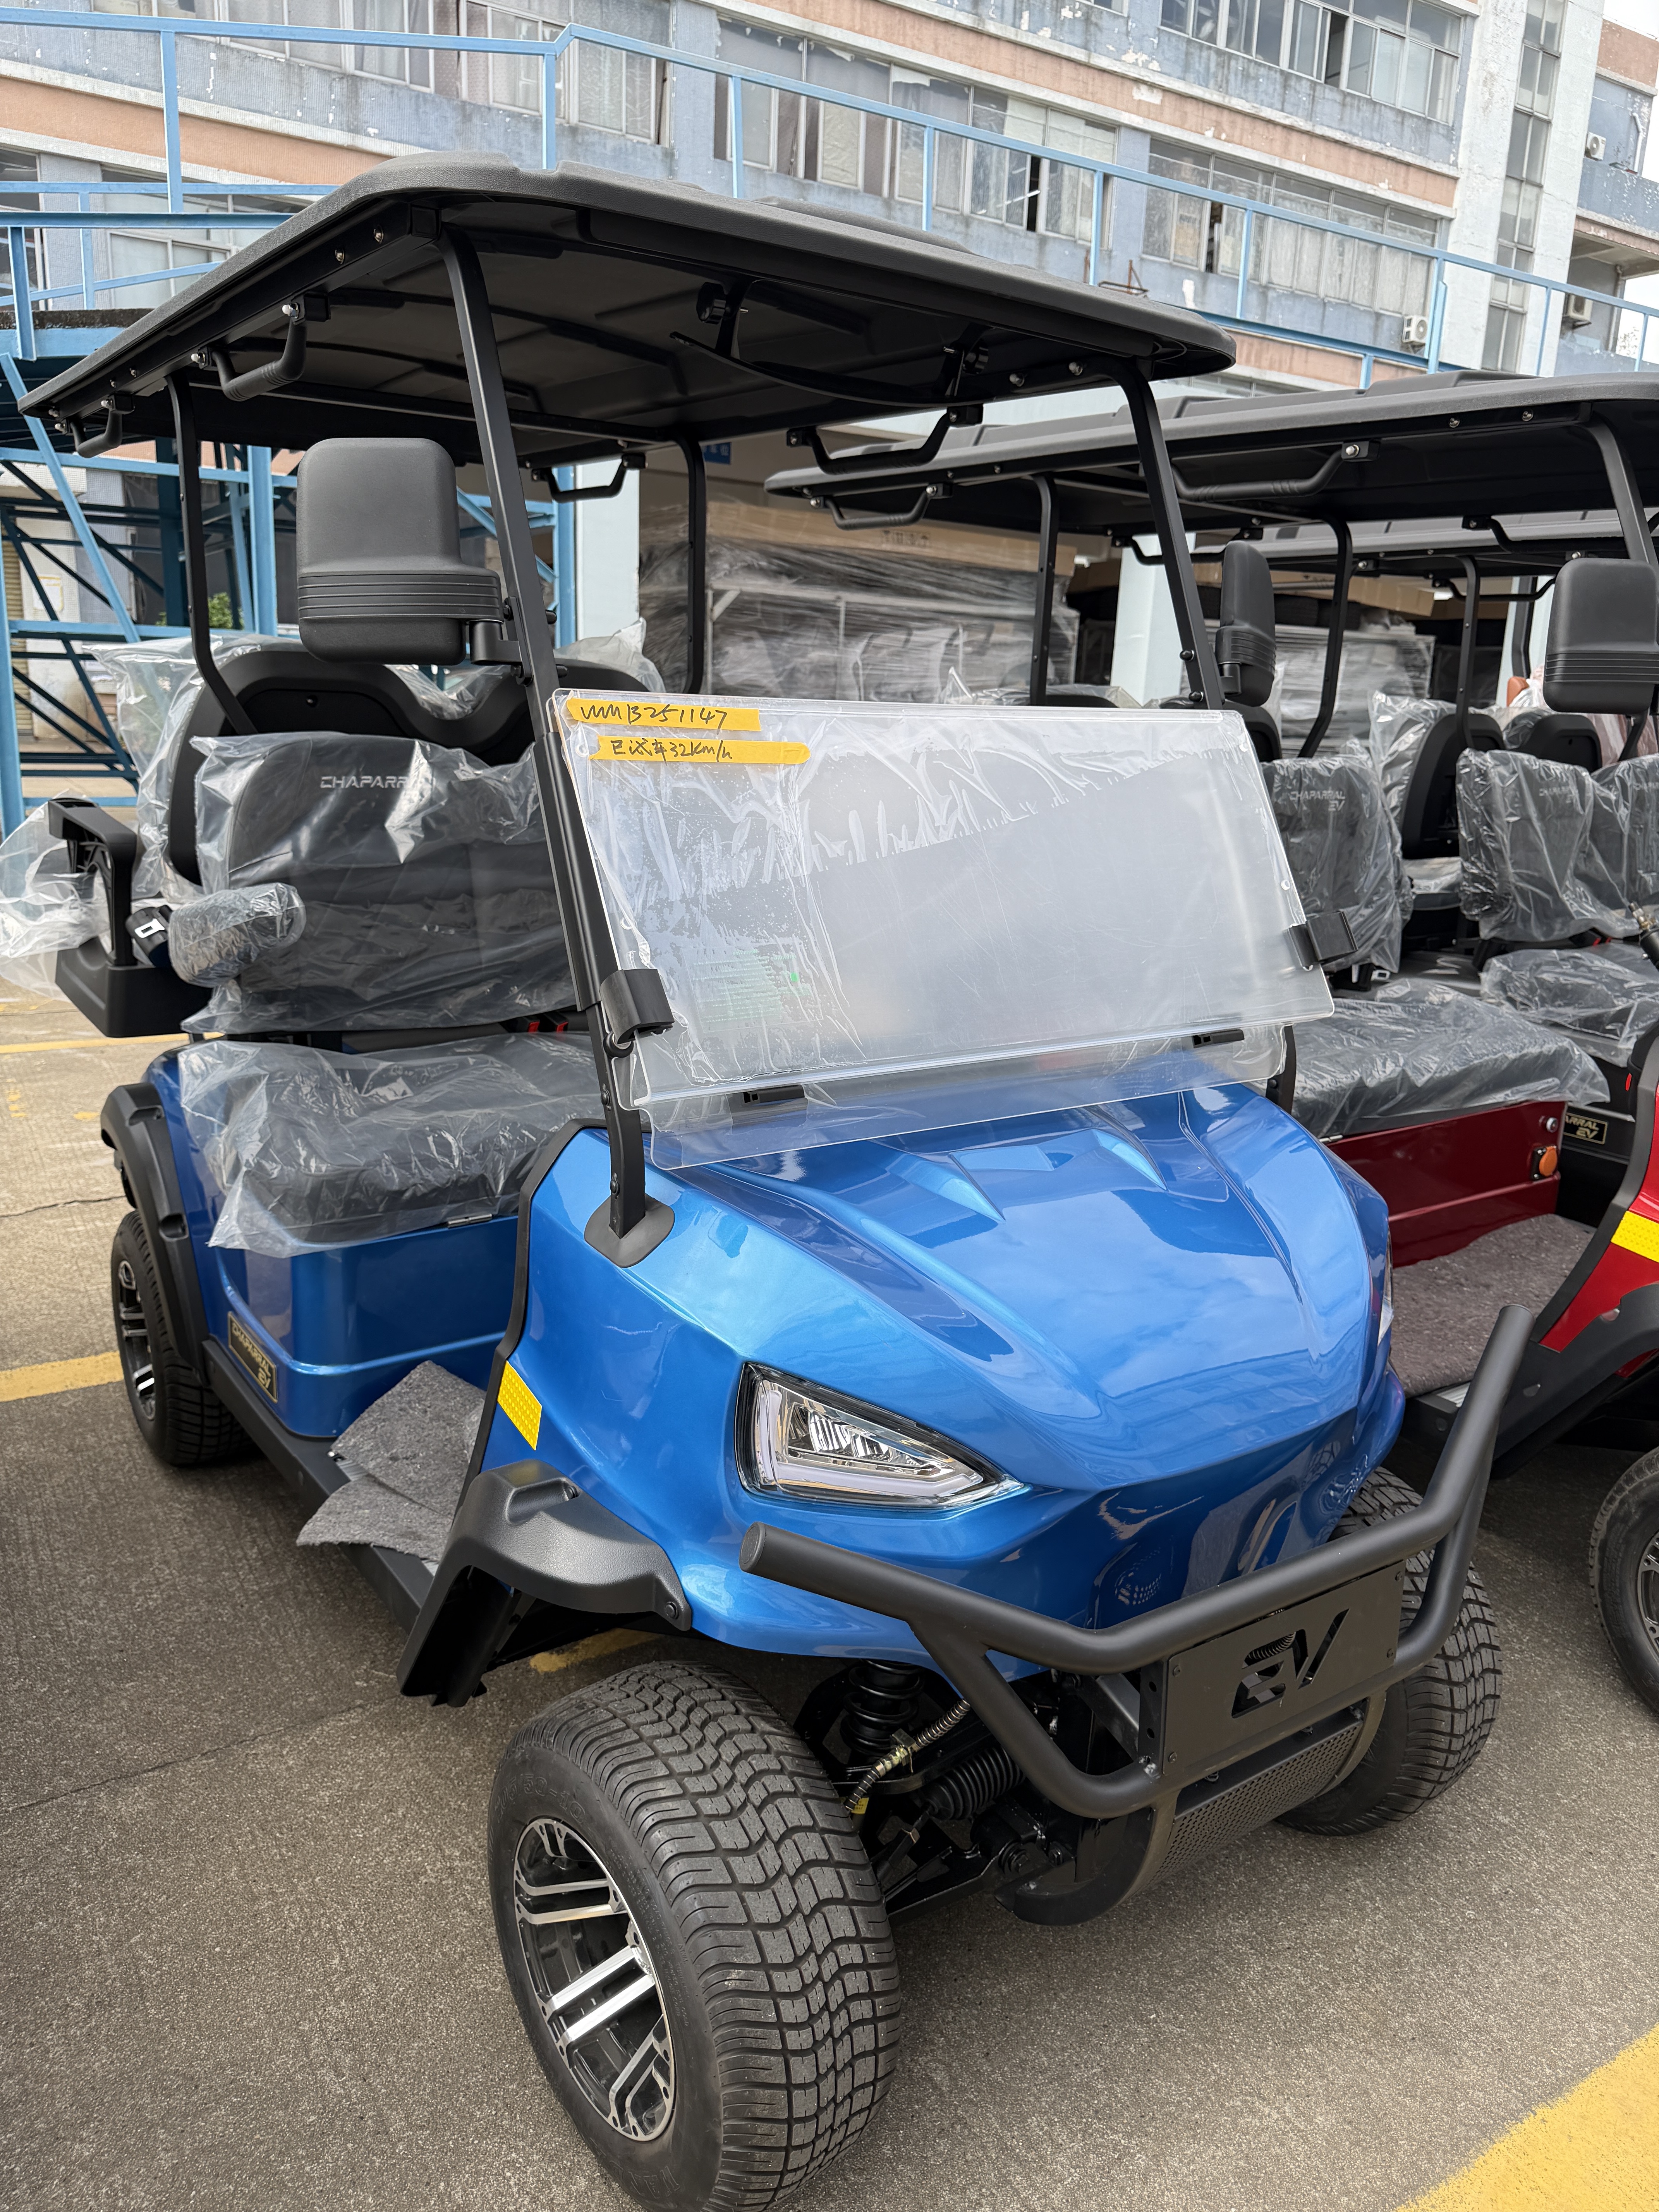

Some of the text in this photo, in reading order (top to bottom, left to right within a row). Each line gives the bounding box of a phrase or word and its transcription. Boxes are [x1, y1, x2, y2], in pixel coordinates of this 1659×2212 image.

[320, 776, 409, 788] CHAPARR
[1576, 1127, 1598, 1139] EV
[1231, 1608, 1350, 1719] EV
